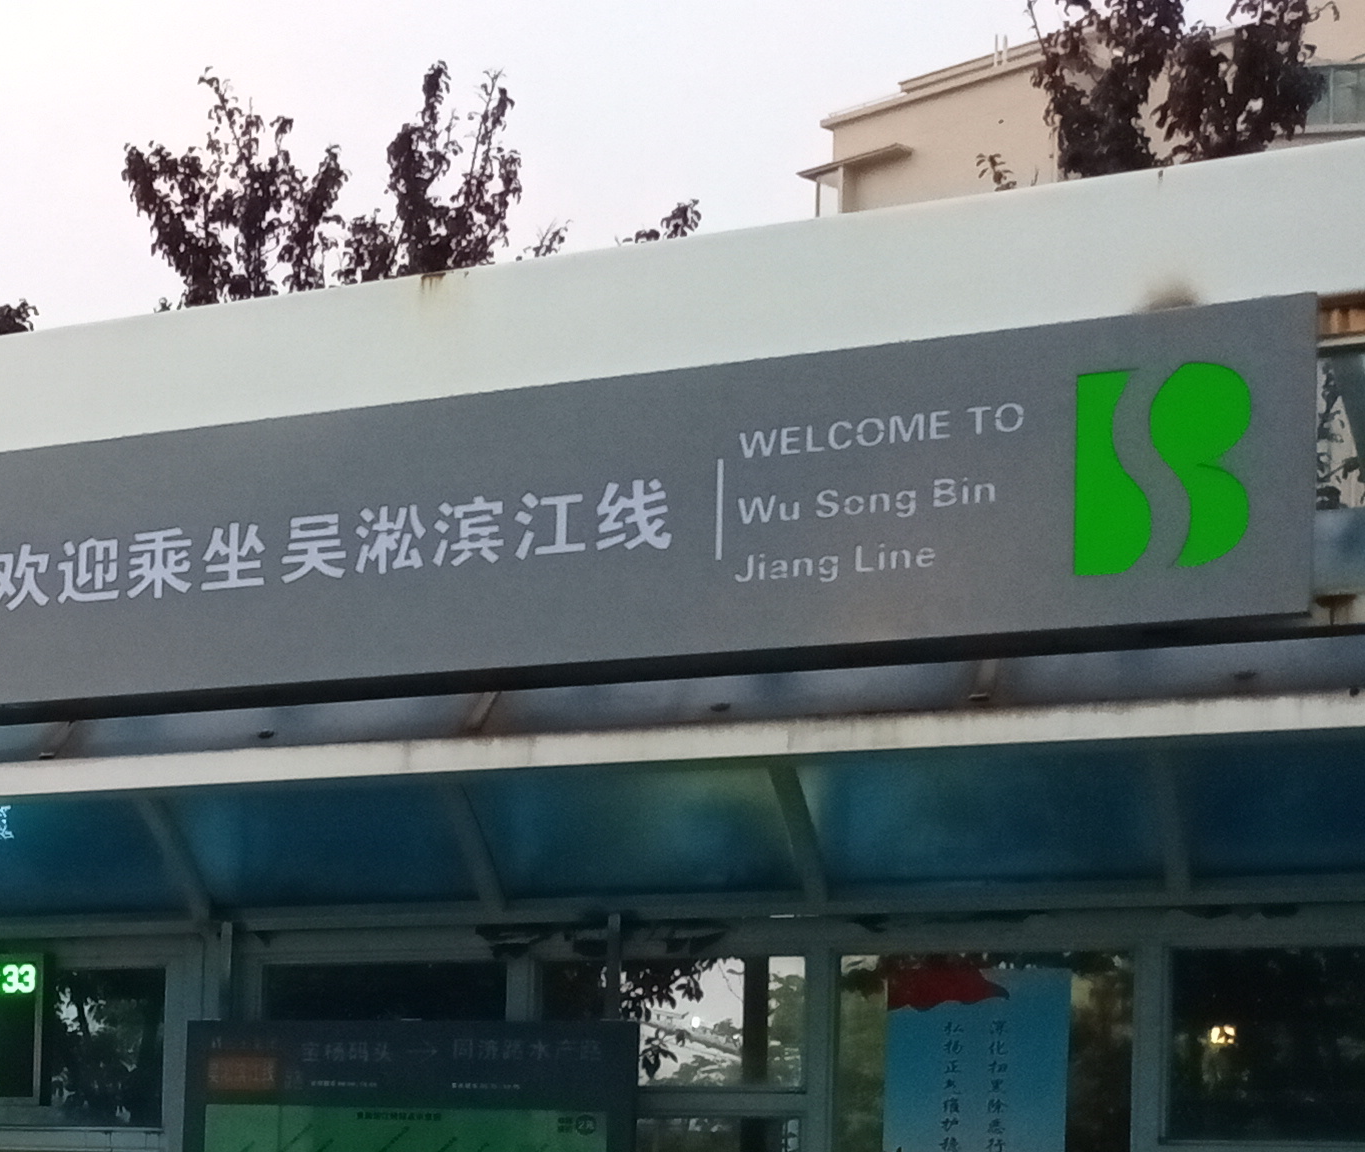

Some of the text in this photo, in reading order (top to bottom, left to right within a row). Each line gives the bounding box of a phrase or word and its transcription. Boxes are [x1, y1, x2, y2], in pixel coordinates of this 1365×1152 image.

[739, 402, 1025, 459] WELCOME TO
[738, 478, 997, 525] Wu Song Bin
[734, 544, 937, 583] Jiang Line
